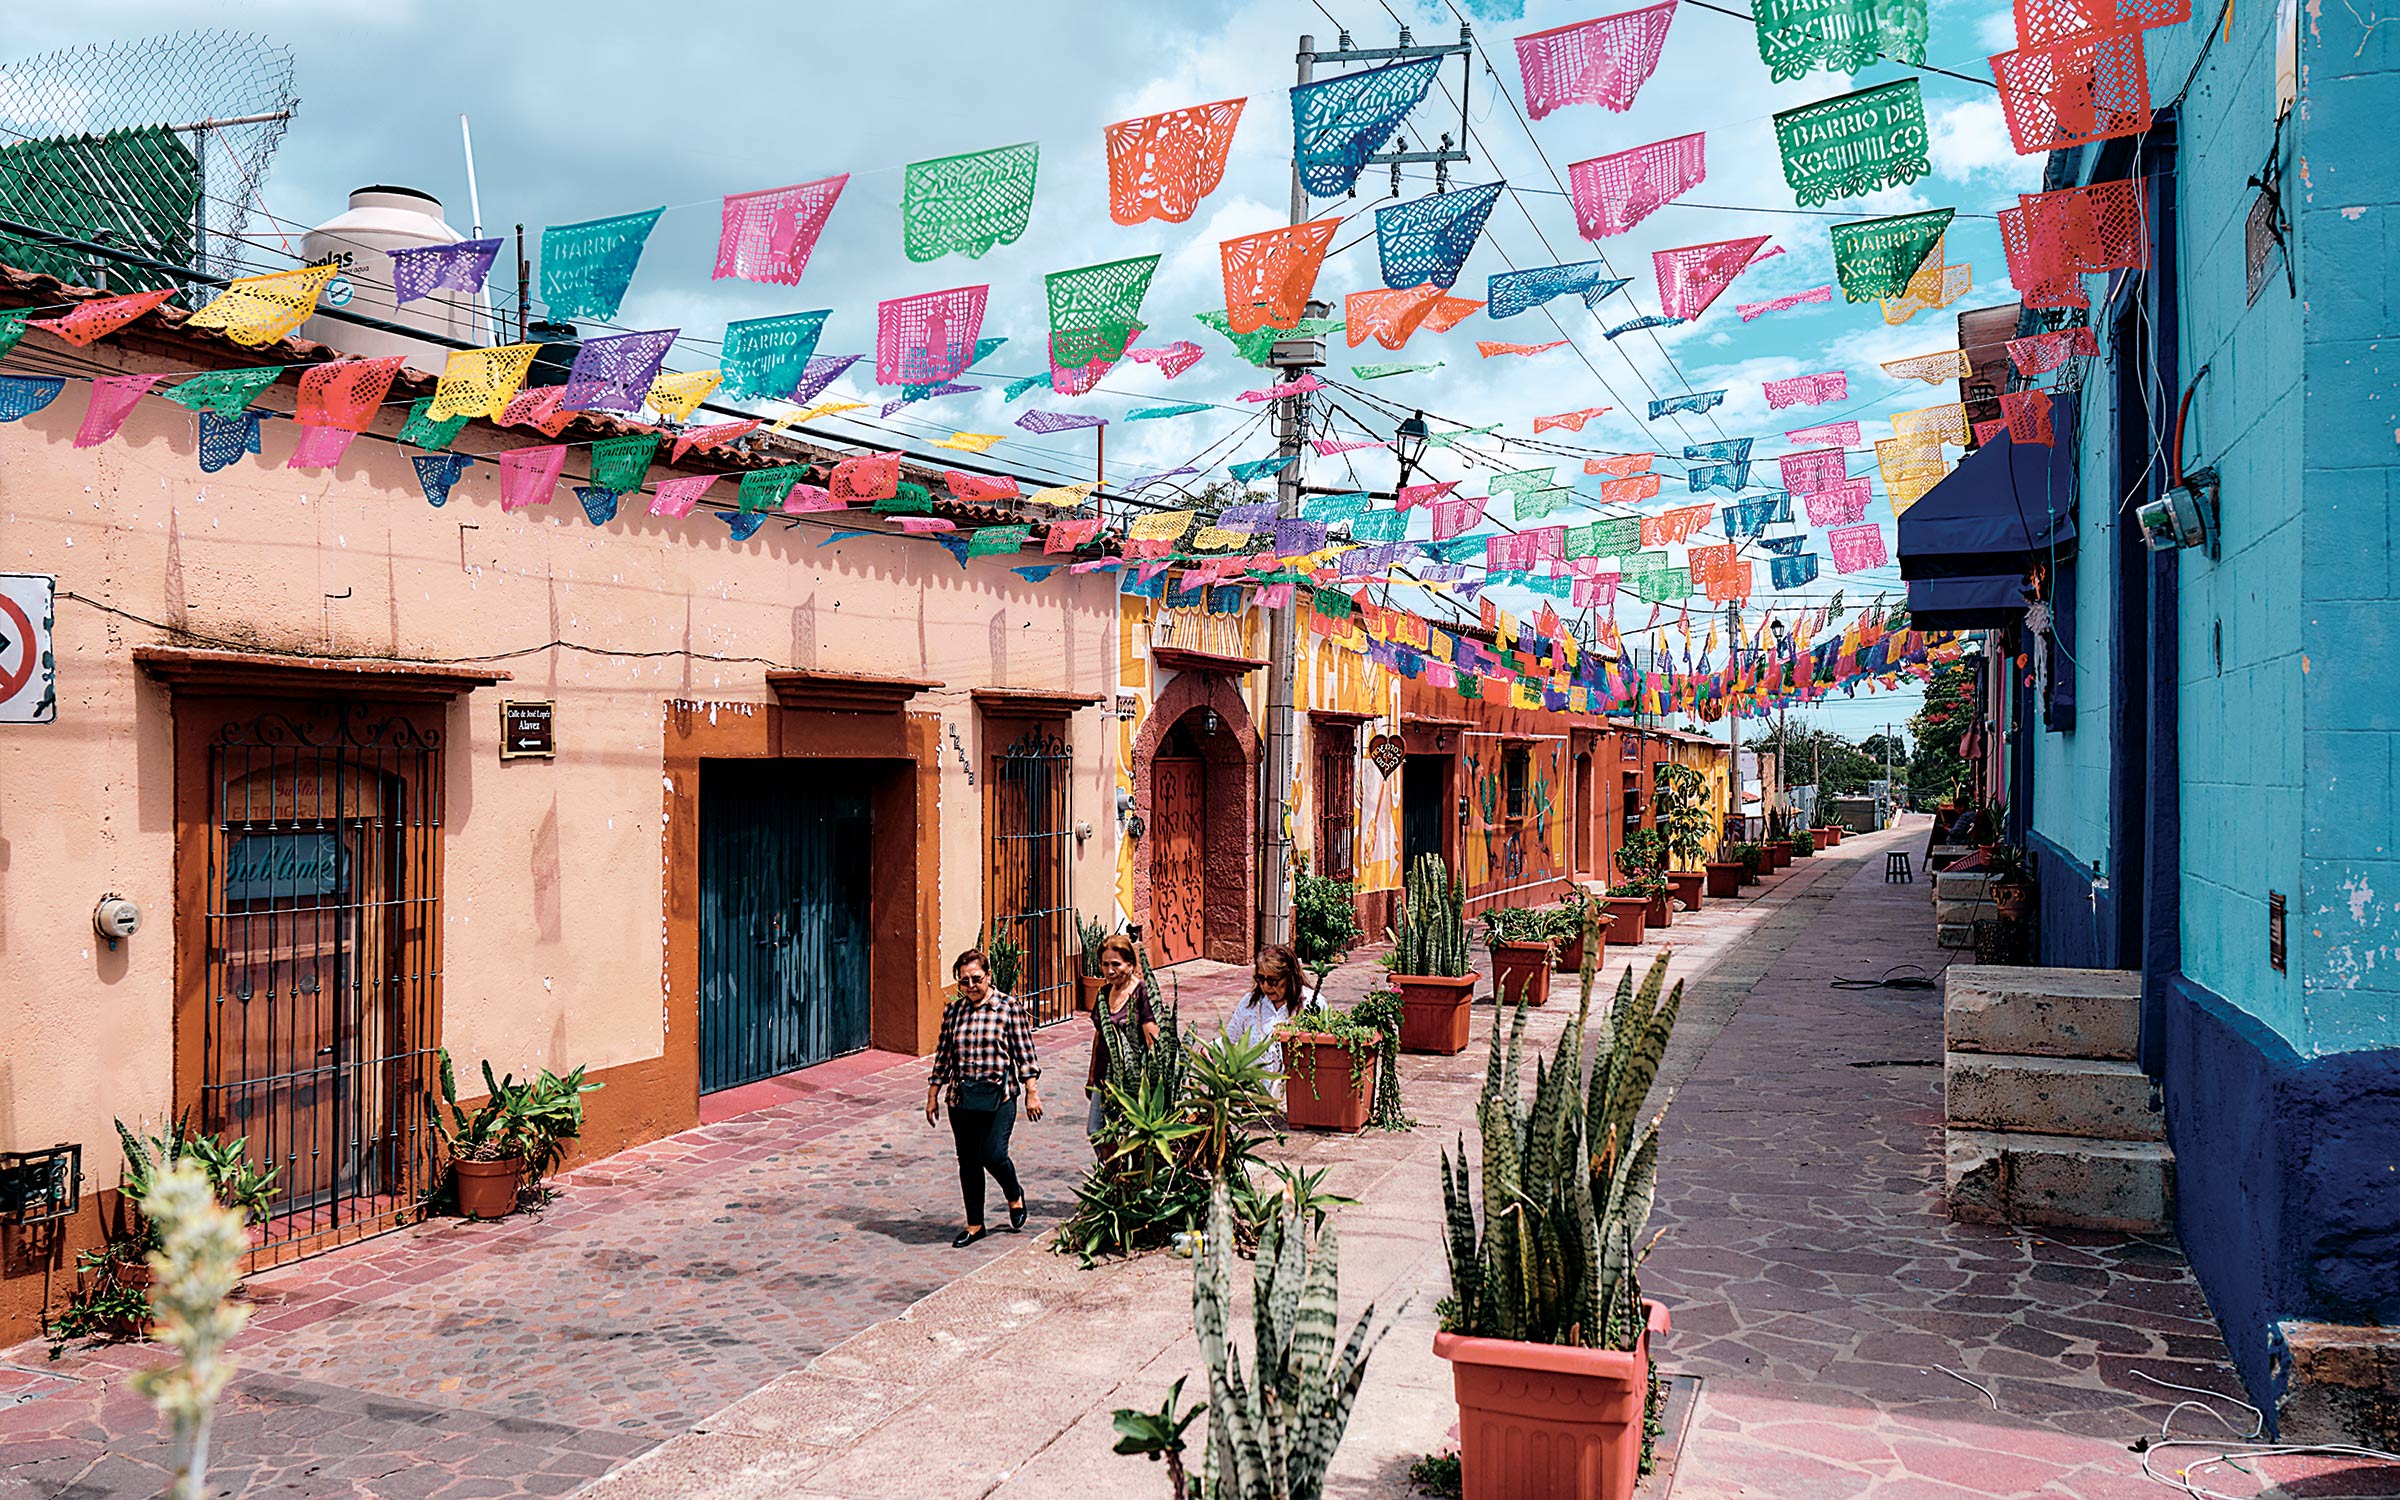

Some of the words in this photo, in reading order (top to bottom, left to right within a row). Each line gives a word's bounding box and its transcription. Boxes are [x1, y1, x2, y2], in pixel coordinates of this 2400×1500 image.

[1764, 6, 1922, 57] XOCHIMILCO
[1793, 109, 1878, 147] BARRIO
[1885, 100, 1914, 125] DE
[1788, 126, 1923, 182] XOCHIMILCO
[1847, 229, 1919, 254] BARRIO
[734, 331, 797, 354] BARRIO
[1787, 458, 1825, 472] BARRIO
[1828, 456, 1841, 465] DE
[1785, 468, 1844, 487] XOCHIMILCO
[507, 709, 520, 718] Calle
[520, 709, 526, 718] de
[526, 709, 536, 718] José
[518, 720, 541, 731] Alavez
